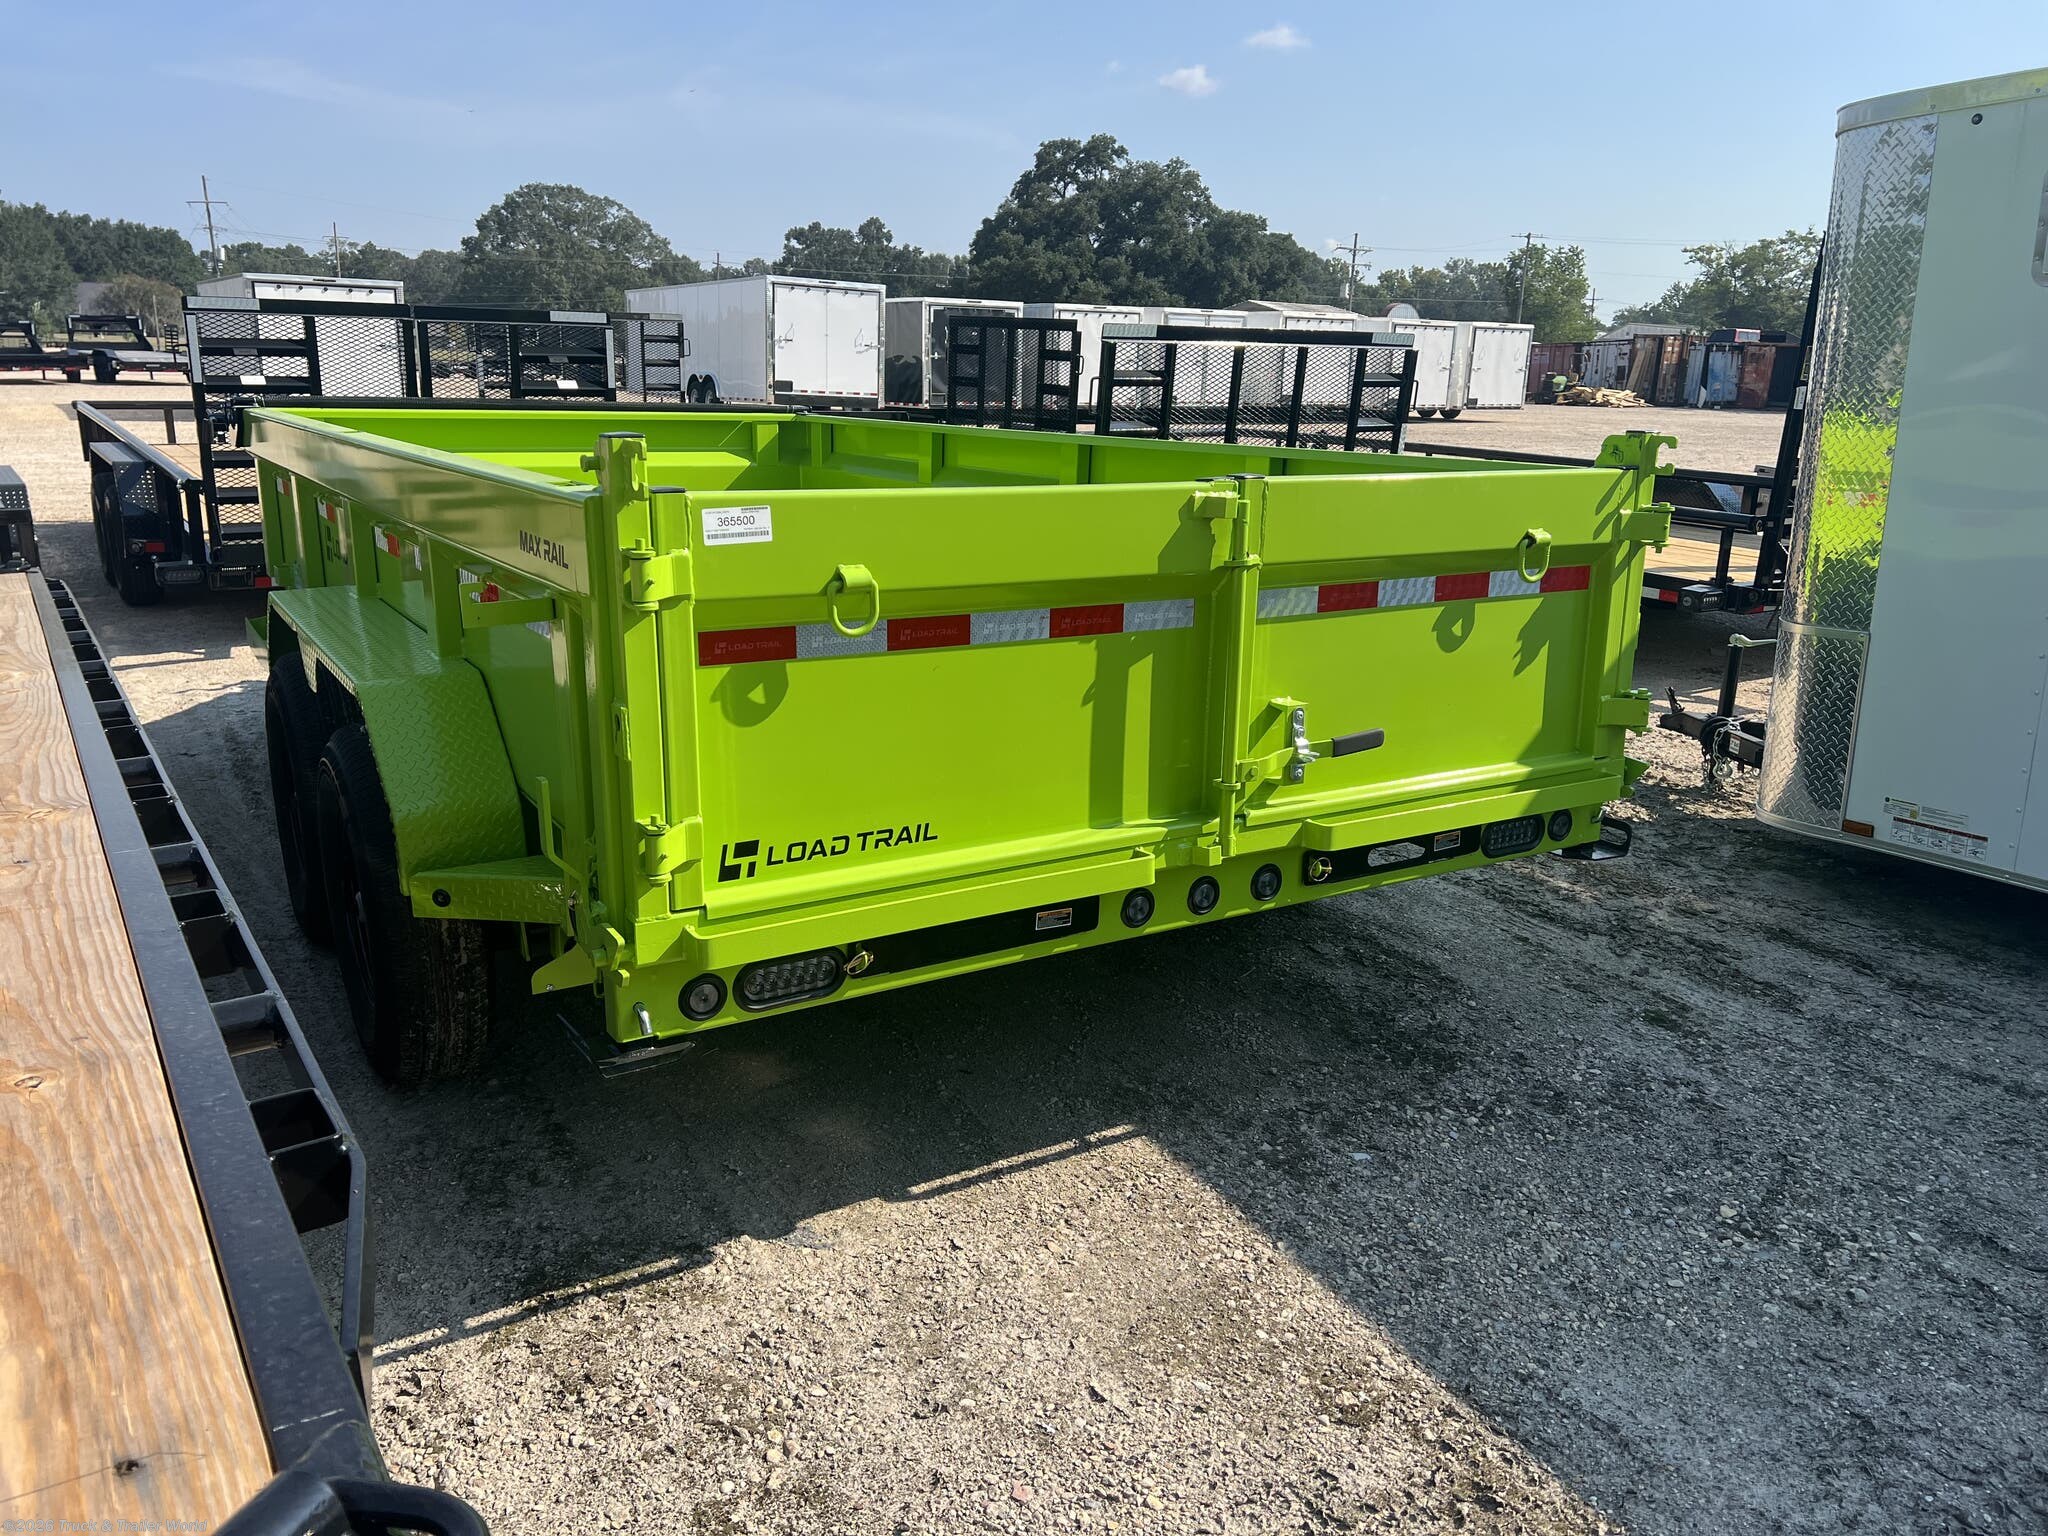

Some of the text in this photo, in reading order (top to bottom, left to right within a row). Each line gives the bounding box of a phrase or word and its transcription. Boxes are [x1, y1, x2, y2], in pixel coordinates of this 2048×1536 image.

[717, 515, 755, 527] 365500
[519, 530, 569, 569] MAX RAIL
[728, 640, 783, 651] LOAD TRAIL
[766, 835, 851, 866] LOAD
[857, 822, 938, 852] TRAIL
